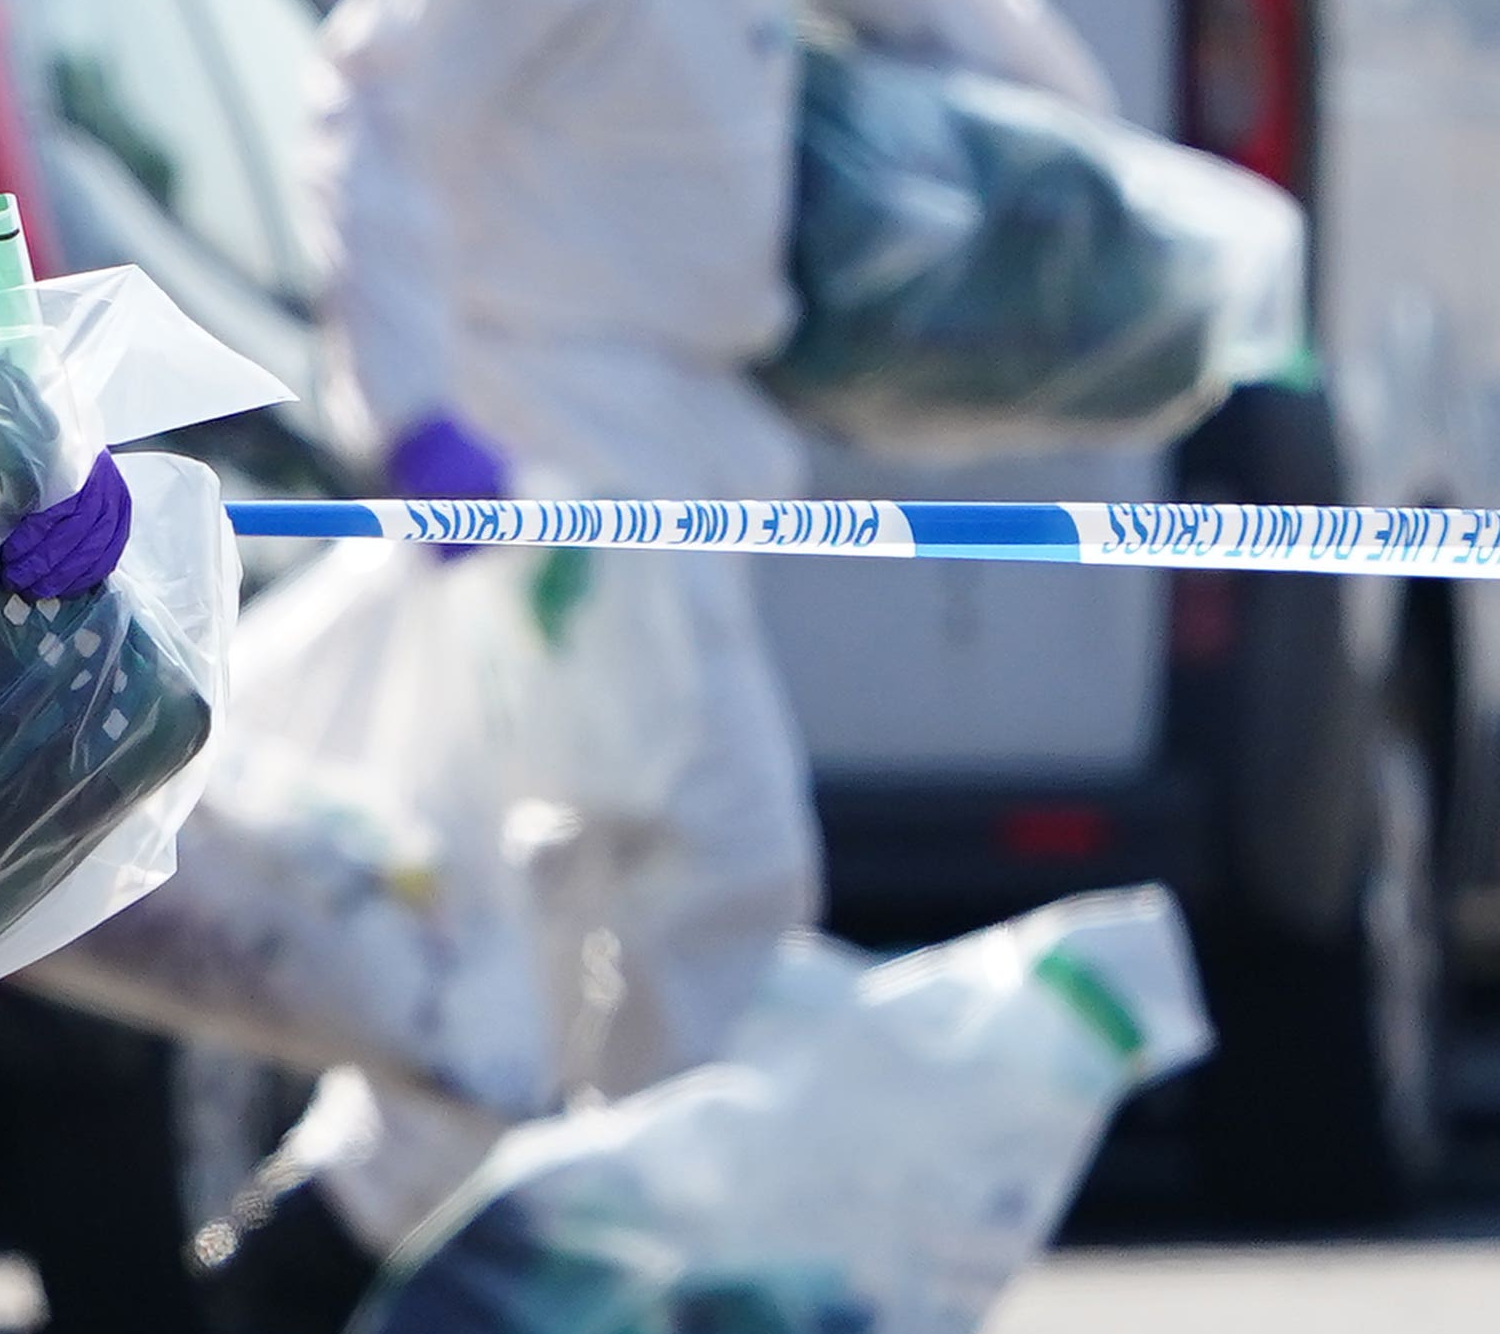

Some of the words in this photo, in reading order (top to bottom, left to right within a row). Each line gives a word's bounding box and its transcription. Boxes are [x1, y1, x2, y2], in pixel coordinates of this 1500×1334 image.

[405, 495, 523, 545] CROSS
[536, 496, 603, 547] NOT
[611, 496, 662, 543] DO
[762, 499, 880, 547] POLICE
[1103, 499, 1224, 555] CROSS
[1226, 505, 1303, 557] NOT
[1309, 506, 1363, 559] DO
[1367, 505, 1450, 560] LINE
